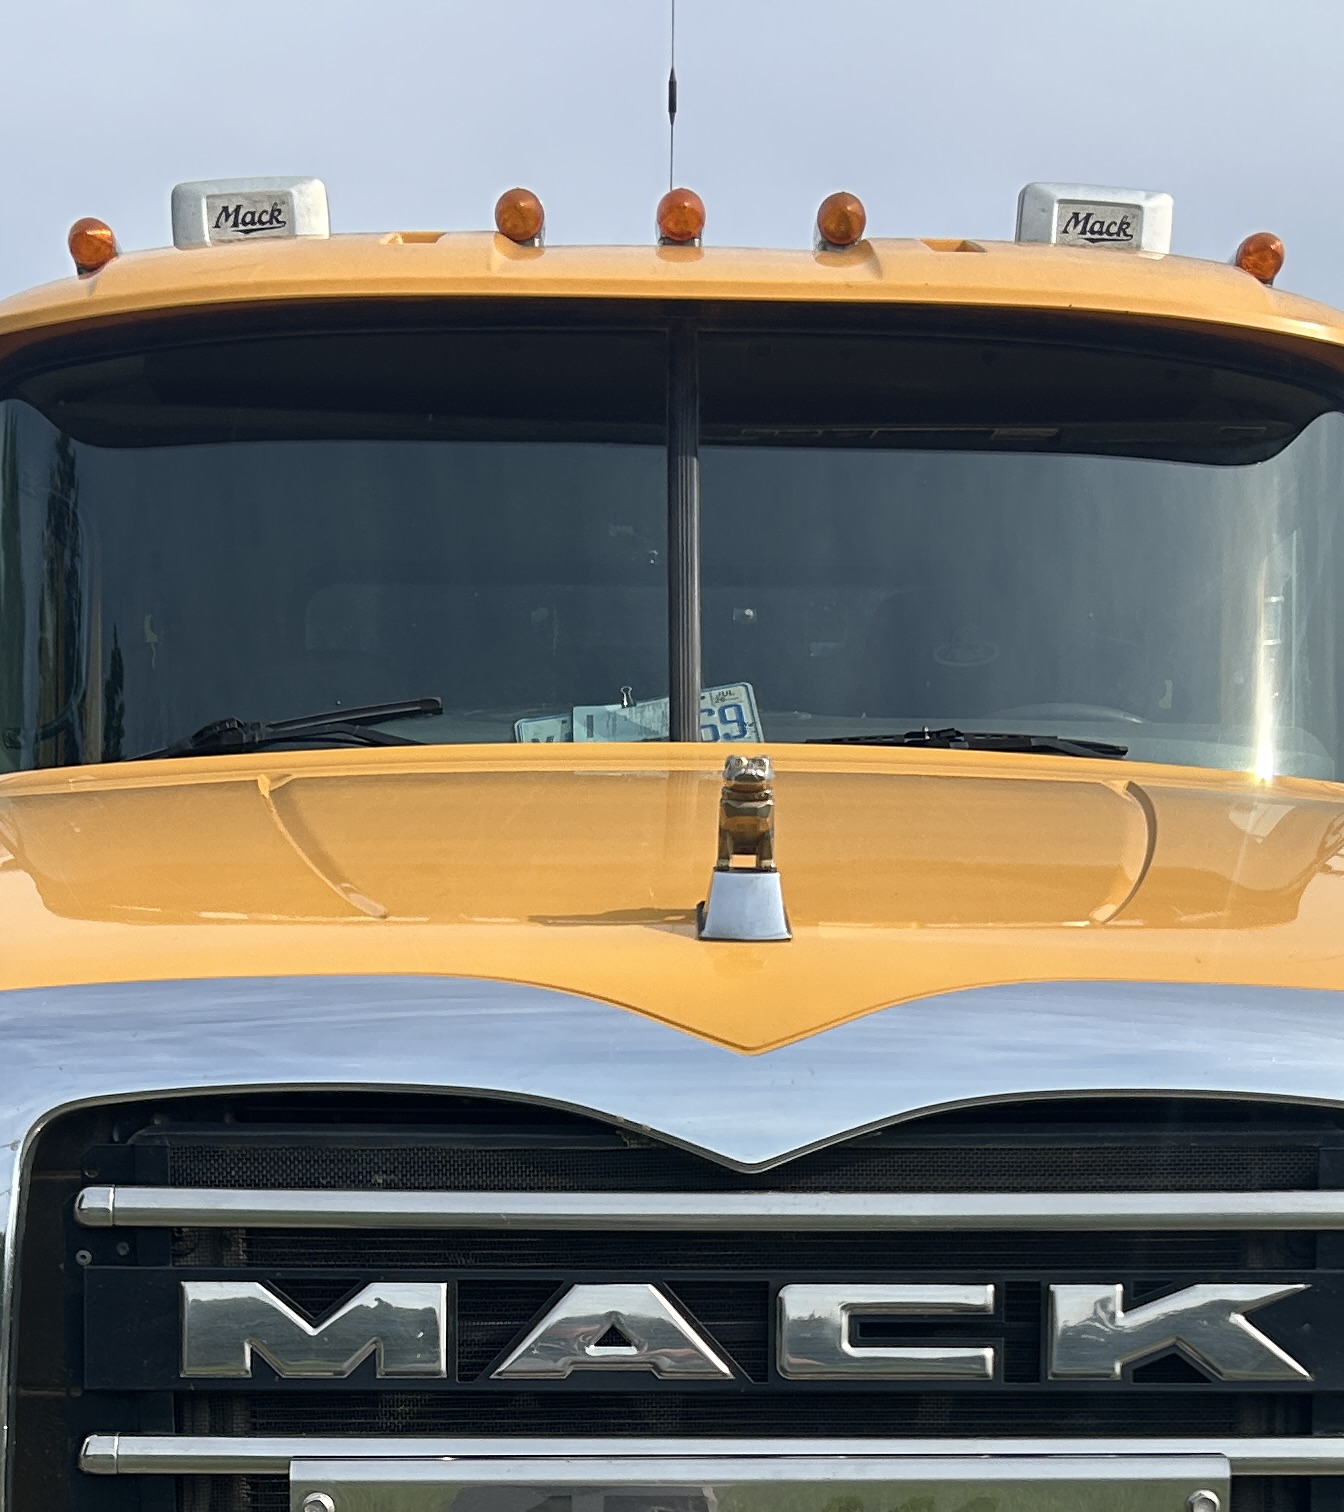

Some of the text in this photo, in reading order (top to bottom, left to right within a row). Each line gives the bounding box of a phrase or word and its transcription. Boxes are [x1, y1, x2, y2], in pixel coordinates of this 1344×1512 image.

[212, 202, 286, 234] Mack
[1062, 212, 1133, 242] Mack
[180, 1281, 1315, 1381] MACK
